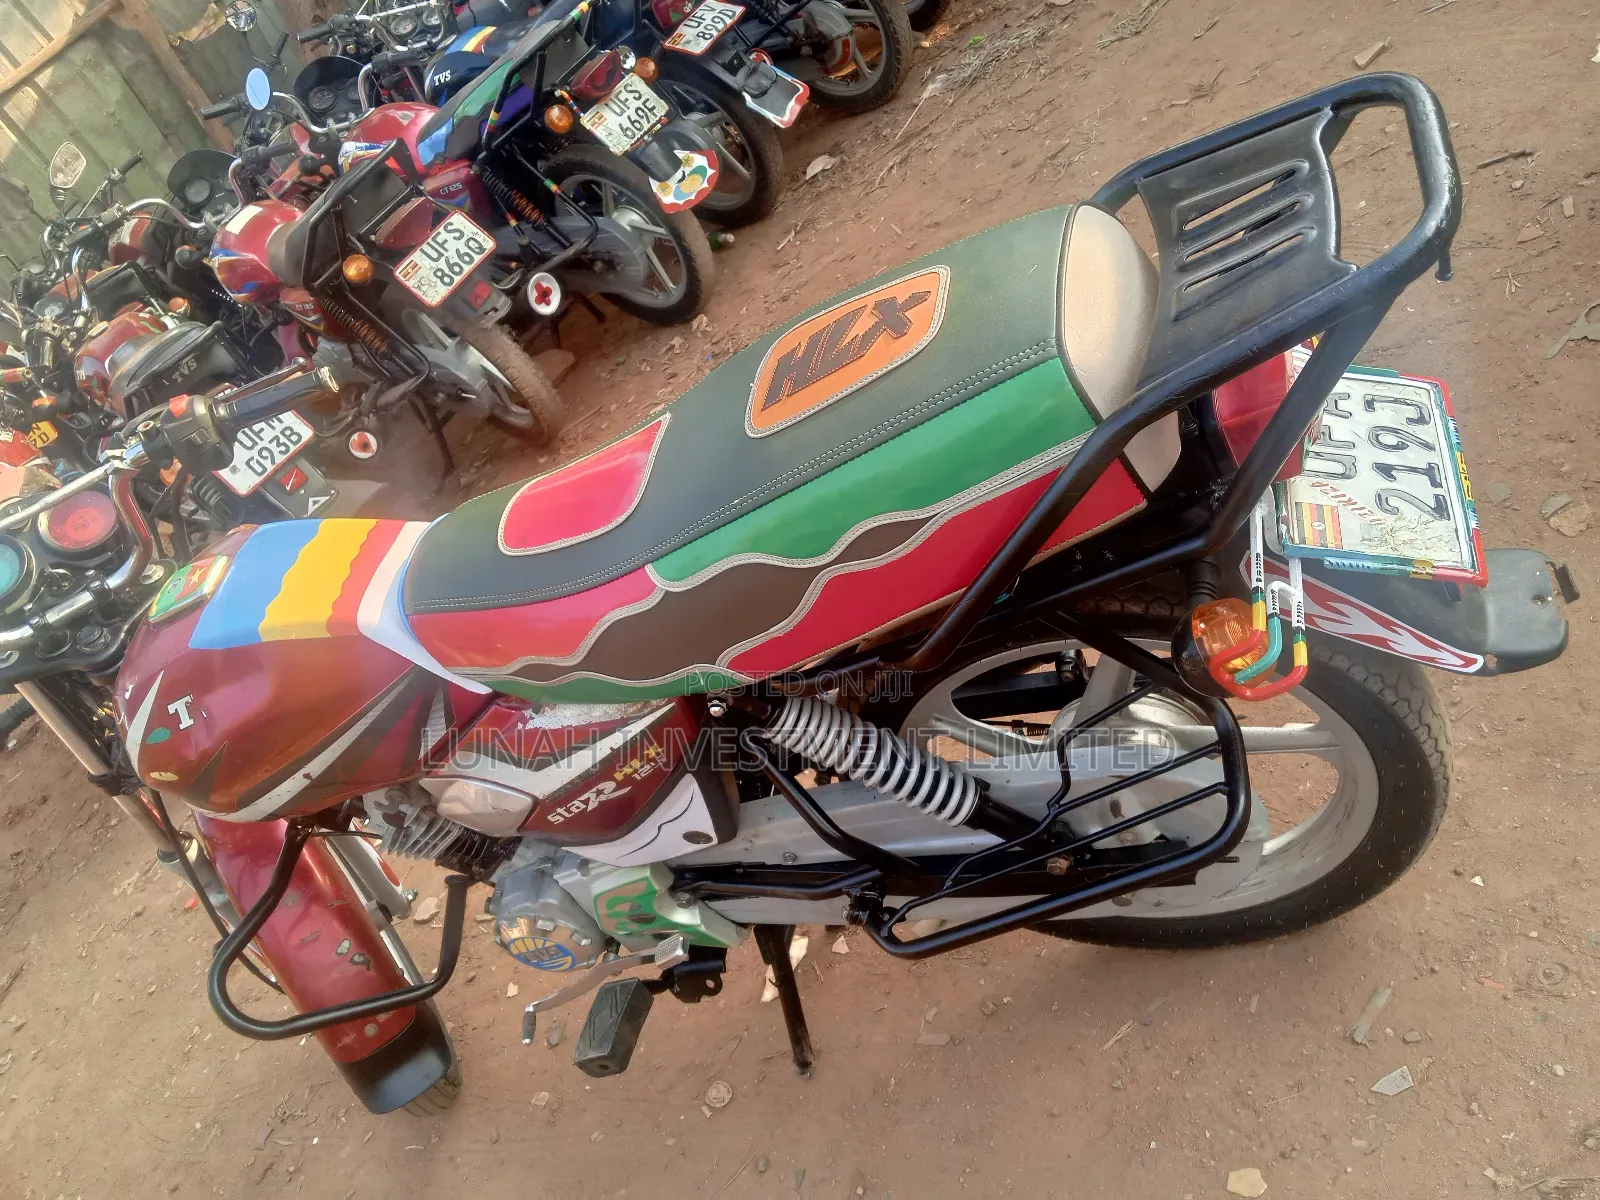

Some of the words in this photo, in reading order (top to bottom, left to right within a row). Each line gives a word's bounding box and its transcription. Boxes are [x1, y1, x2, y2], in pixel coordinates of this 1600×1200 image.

[683, 4, 717, 28] UFV
[696, 8, 737, 40] 899D
[433, 70, 451, 86] TVS
[604, 83, 642, 117] UFS
[618, 98, 657, 139] 669F
[420, 222, 465, 262] UFS
[433, 237, 487, 286] 866Q
[760, 291, 931, 412] HLX
[172, 358, 197, 383] TVS
[1363, 394, 1451, 521] 219J
